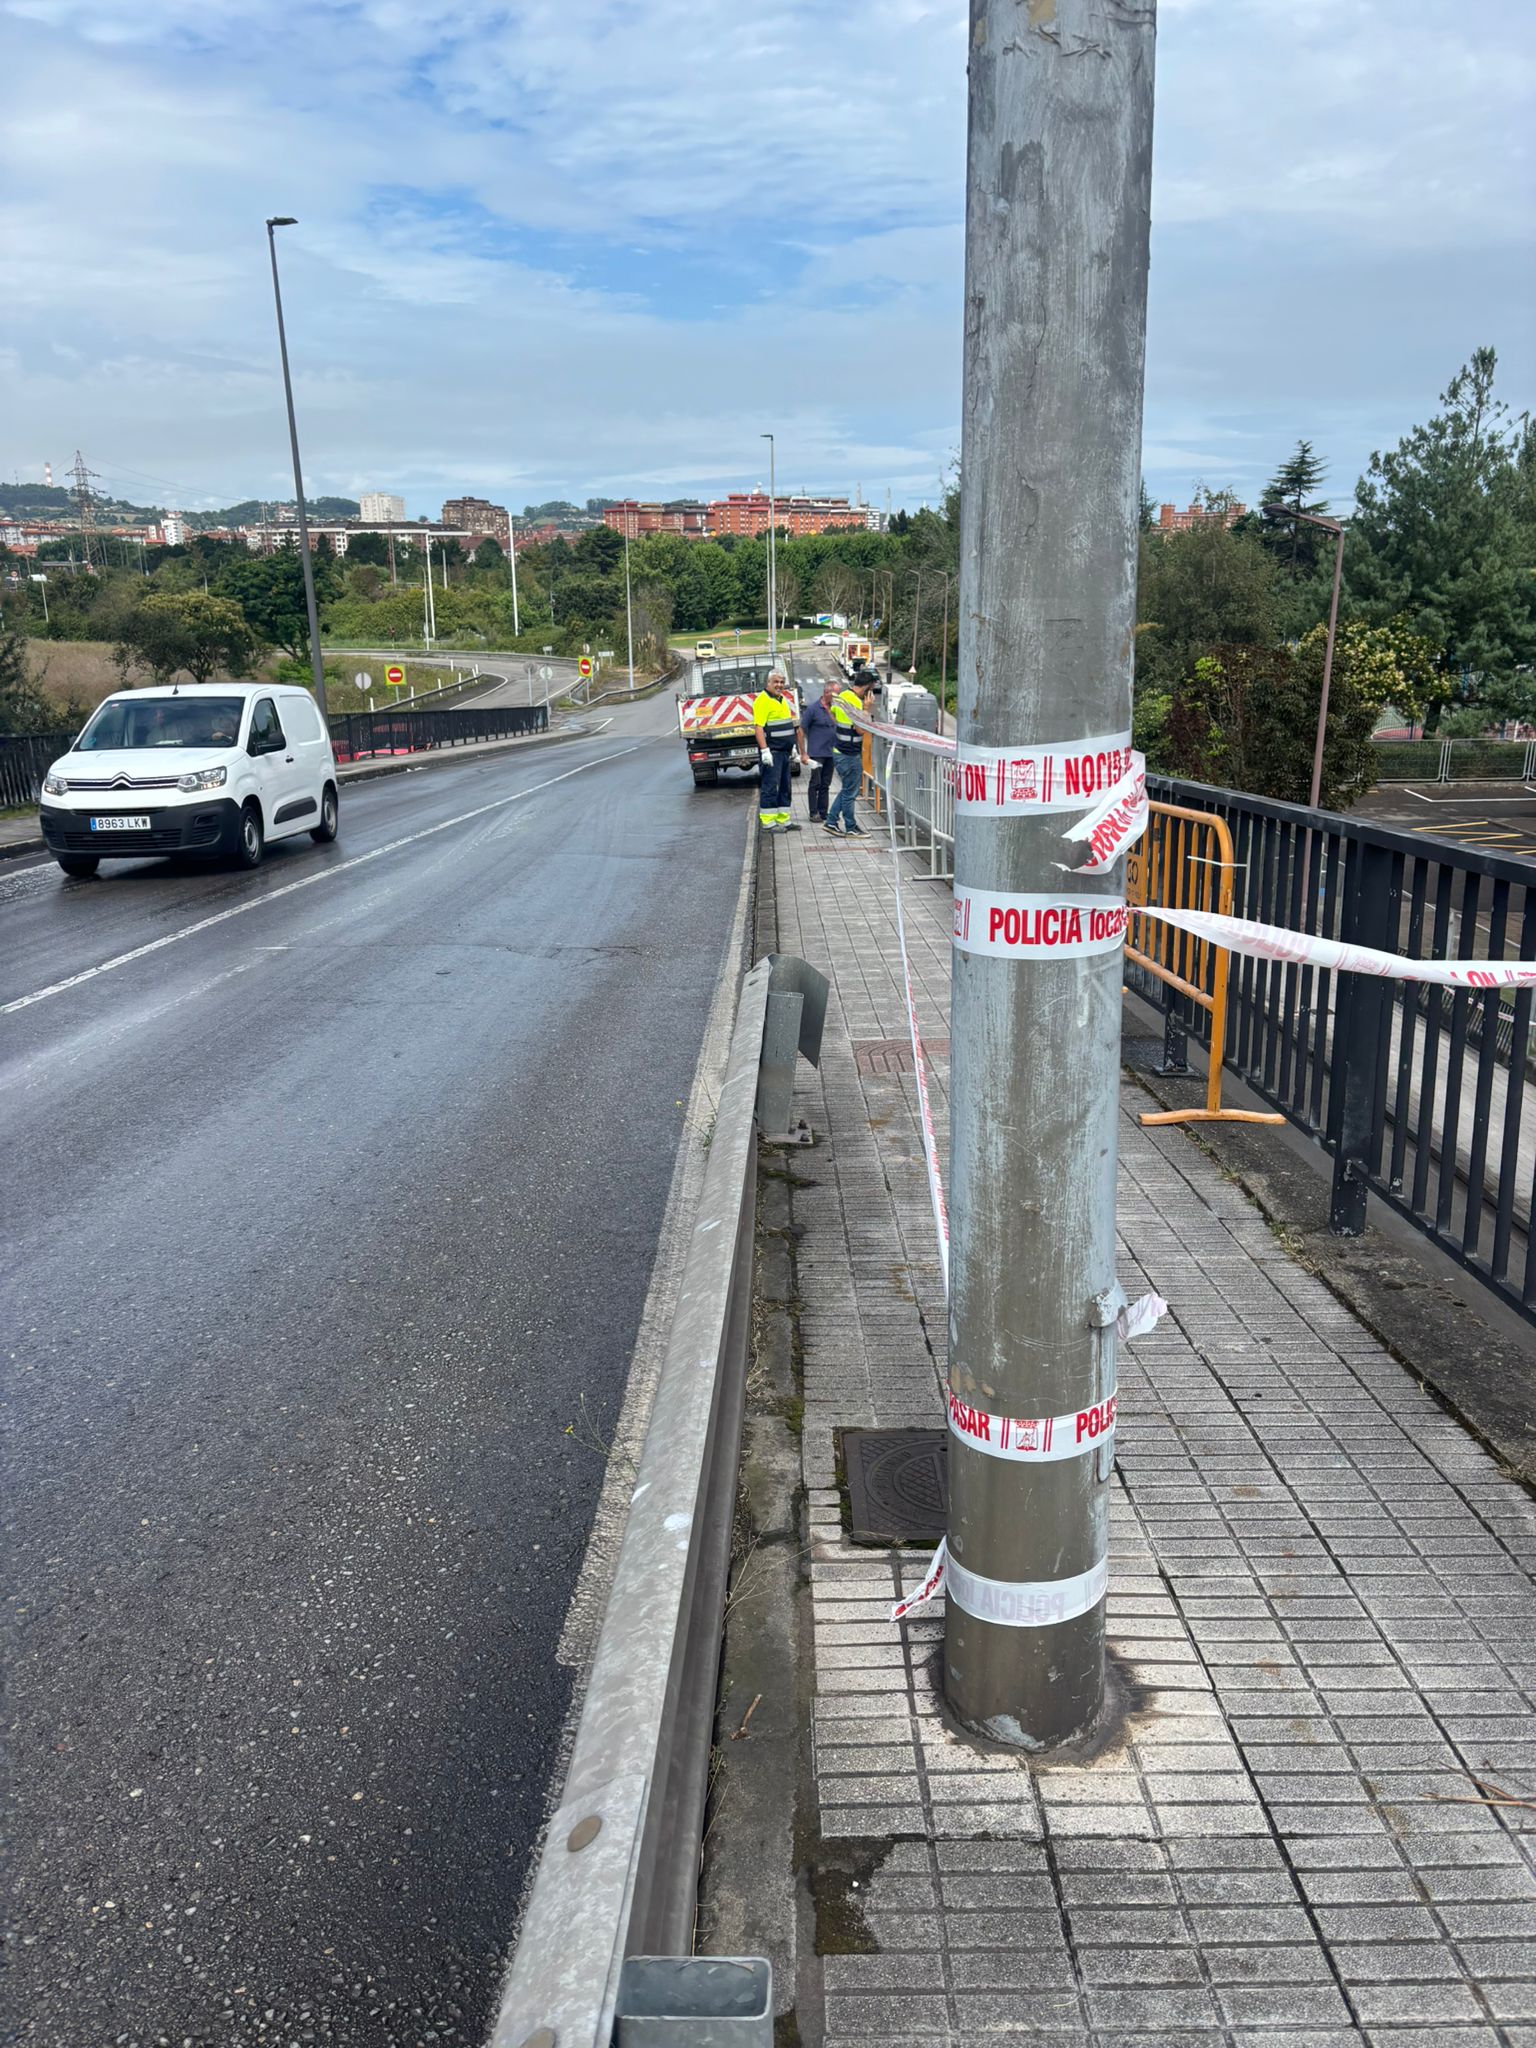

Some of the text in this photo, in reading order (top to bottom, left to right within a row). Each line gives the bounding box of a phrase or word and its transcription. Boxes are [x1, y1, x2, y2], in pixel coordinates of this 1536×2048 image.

[97, 817, 148, 829] 8963 LKW
[990, 908, 1083, 946] POLICIA
